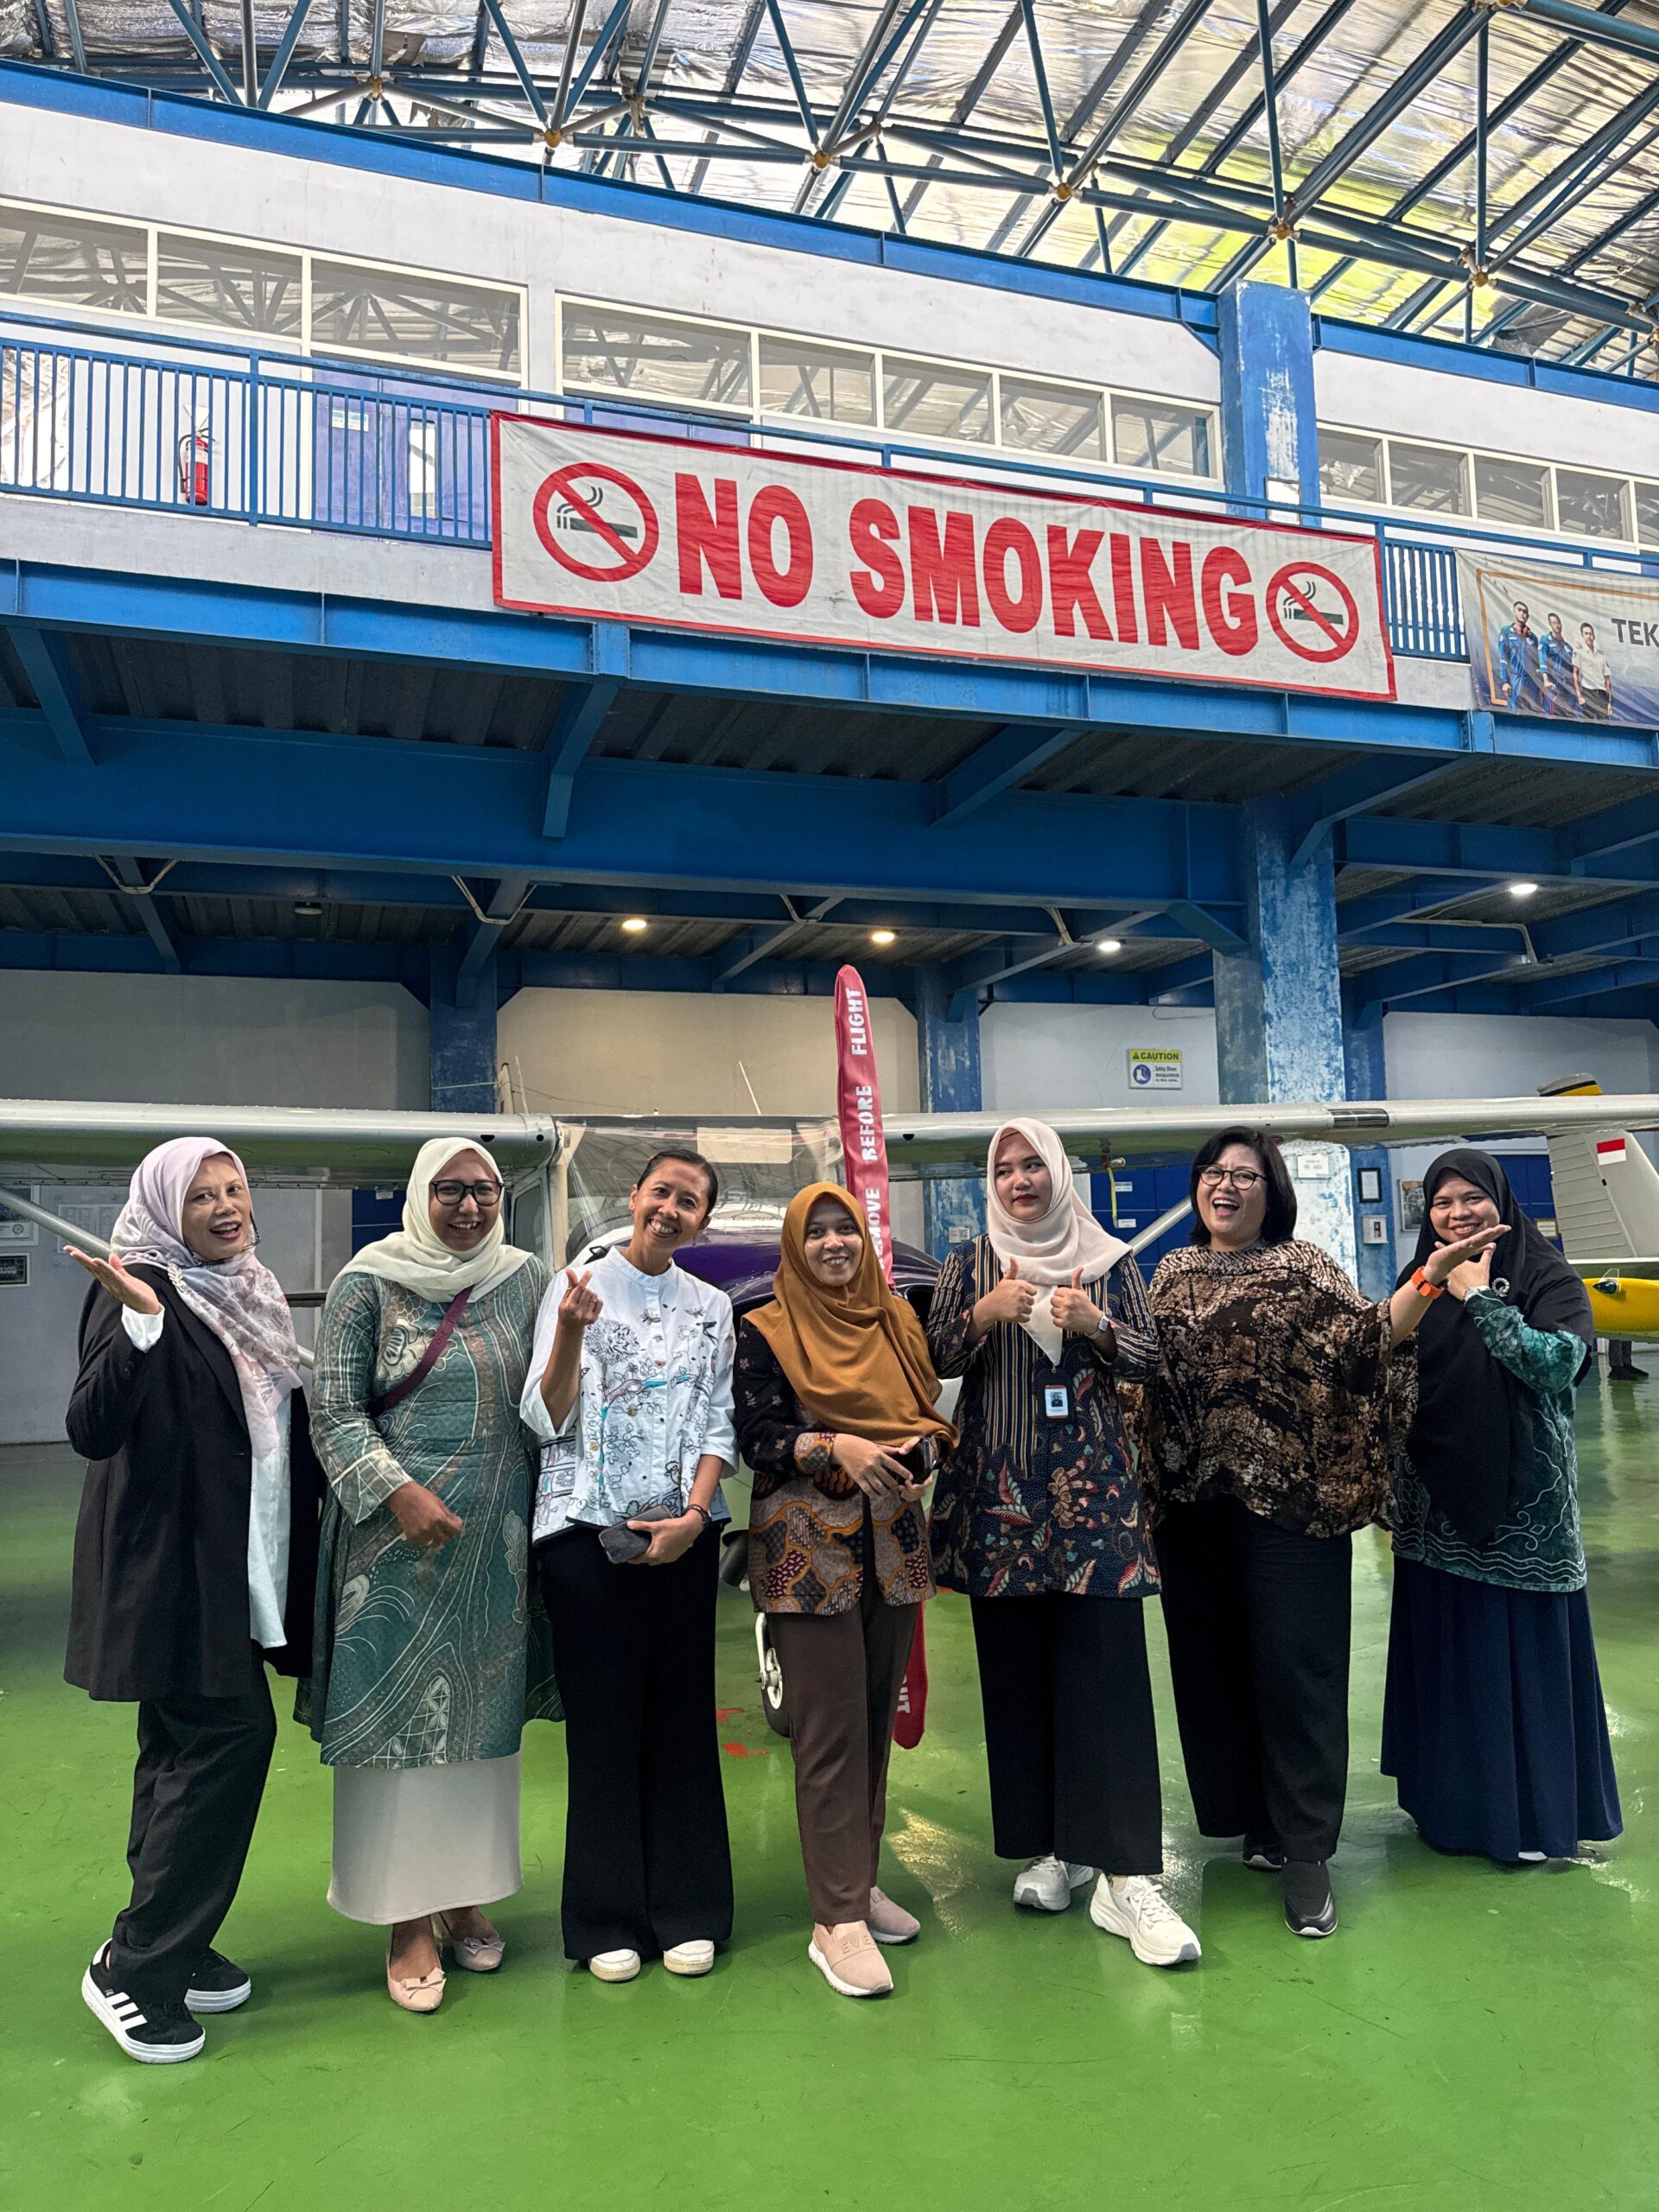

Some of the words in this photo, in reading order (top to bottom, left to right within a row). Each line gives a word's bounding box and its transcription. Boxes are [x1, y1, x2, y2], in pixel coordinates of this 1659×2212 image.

[675, 473, 813, 608] NO
[849, 499, 1259, 656] SMOKING
[1611, 618, 1659, 648] TEK
[846, 988, 868, 1055] FLIGHT
[1141, 1052, 1179, 1061] CAUTION
[855, 1085, 878, 1160] BEFORE
[866, 1189, 885, 1269] EMOVE
